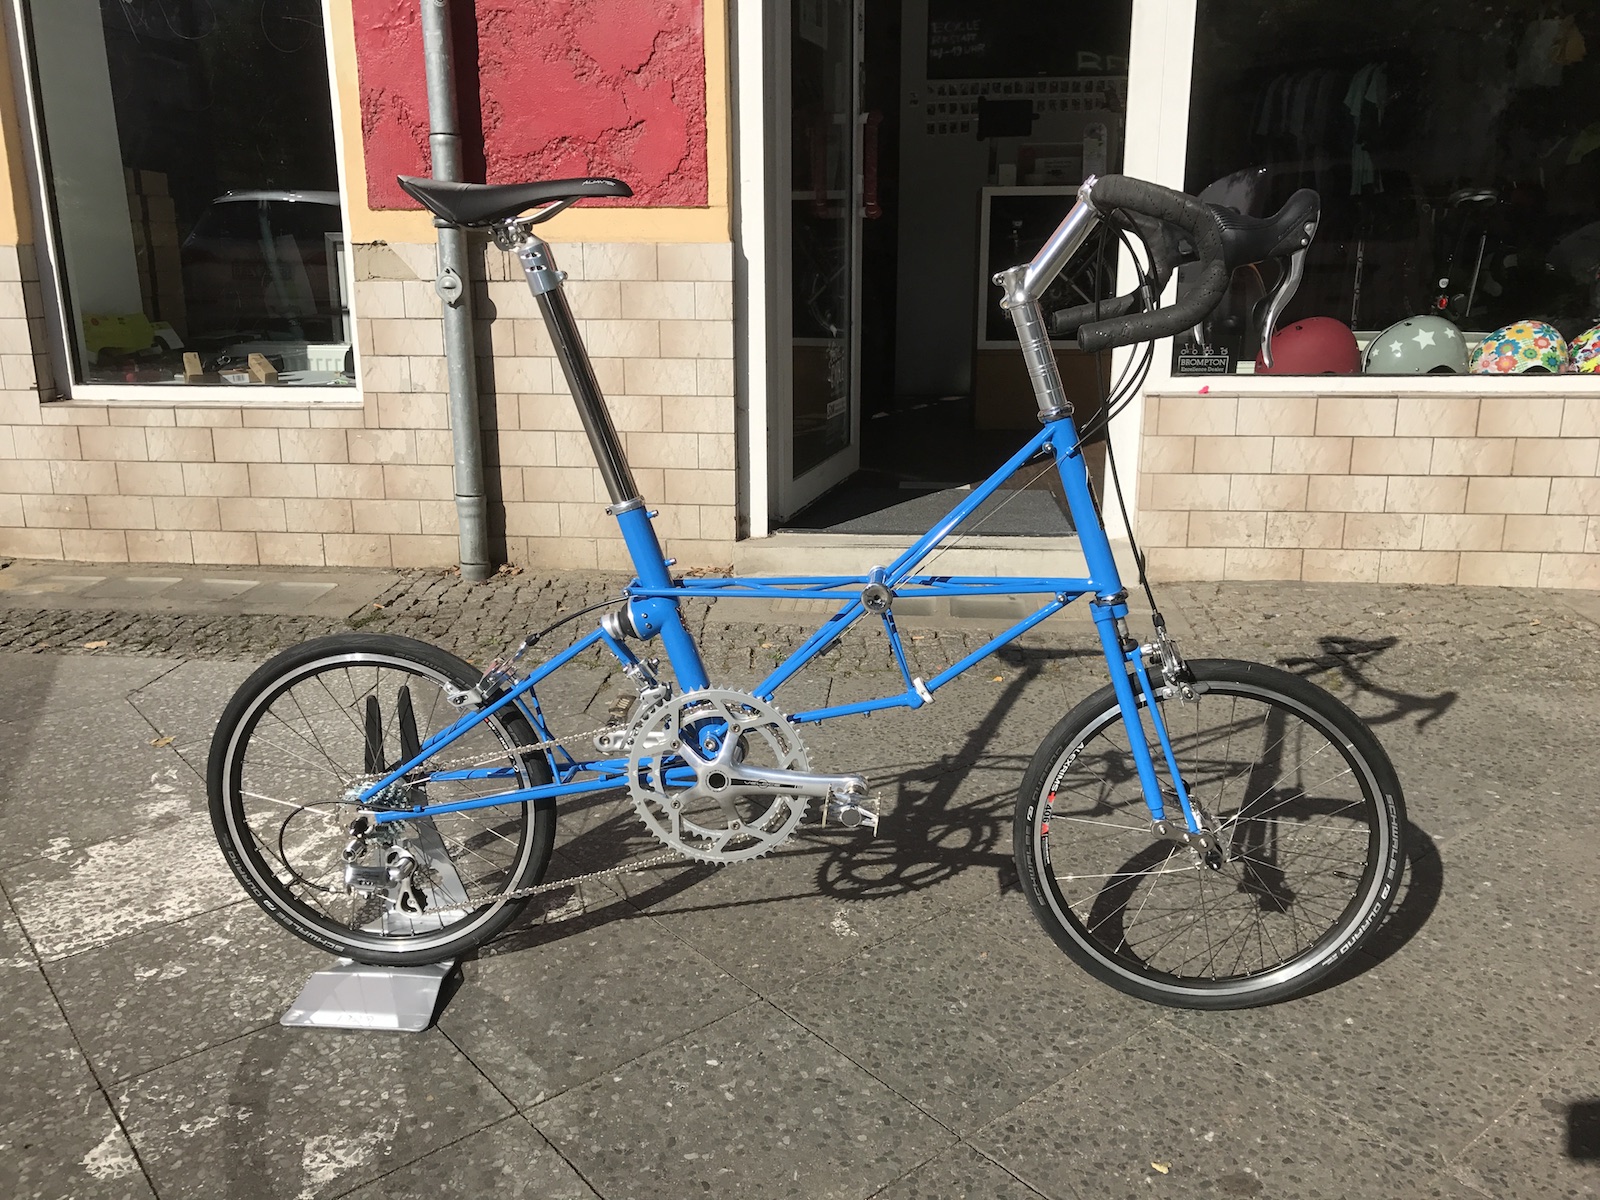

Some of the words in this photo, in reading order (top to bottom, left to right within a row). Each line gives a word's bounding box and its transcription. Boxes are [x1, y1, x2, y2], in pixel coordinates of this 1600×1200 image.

[1180, 358, 1226, 366] BROMPTON
[1051, 742, 1085, 792] ALEXRIMS
[1043, 804, 1053, 824] 406
[1385, 793, 1400, 880] SCHWALBE
[227, 850, 263, 897] DURANO
[275, 911, 346, 952] SCHWALBE
[1339, 902, 1382, 955] DURANO
